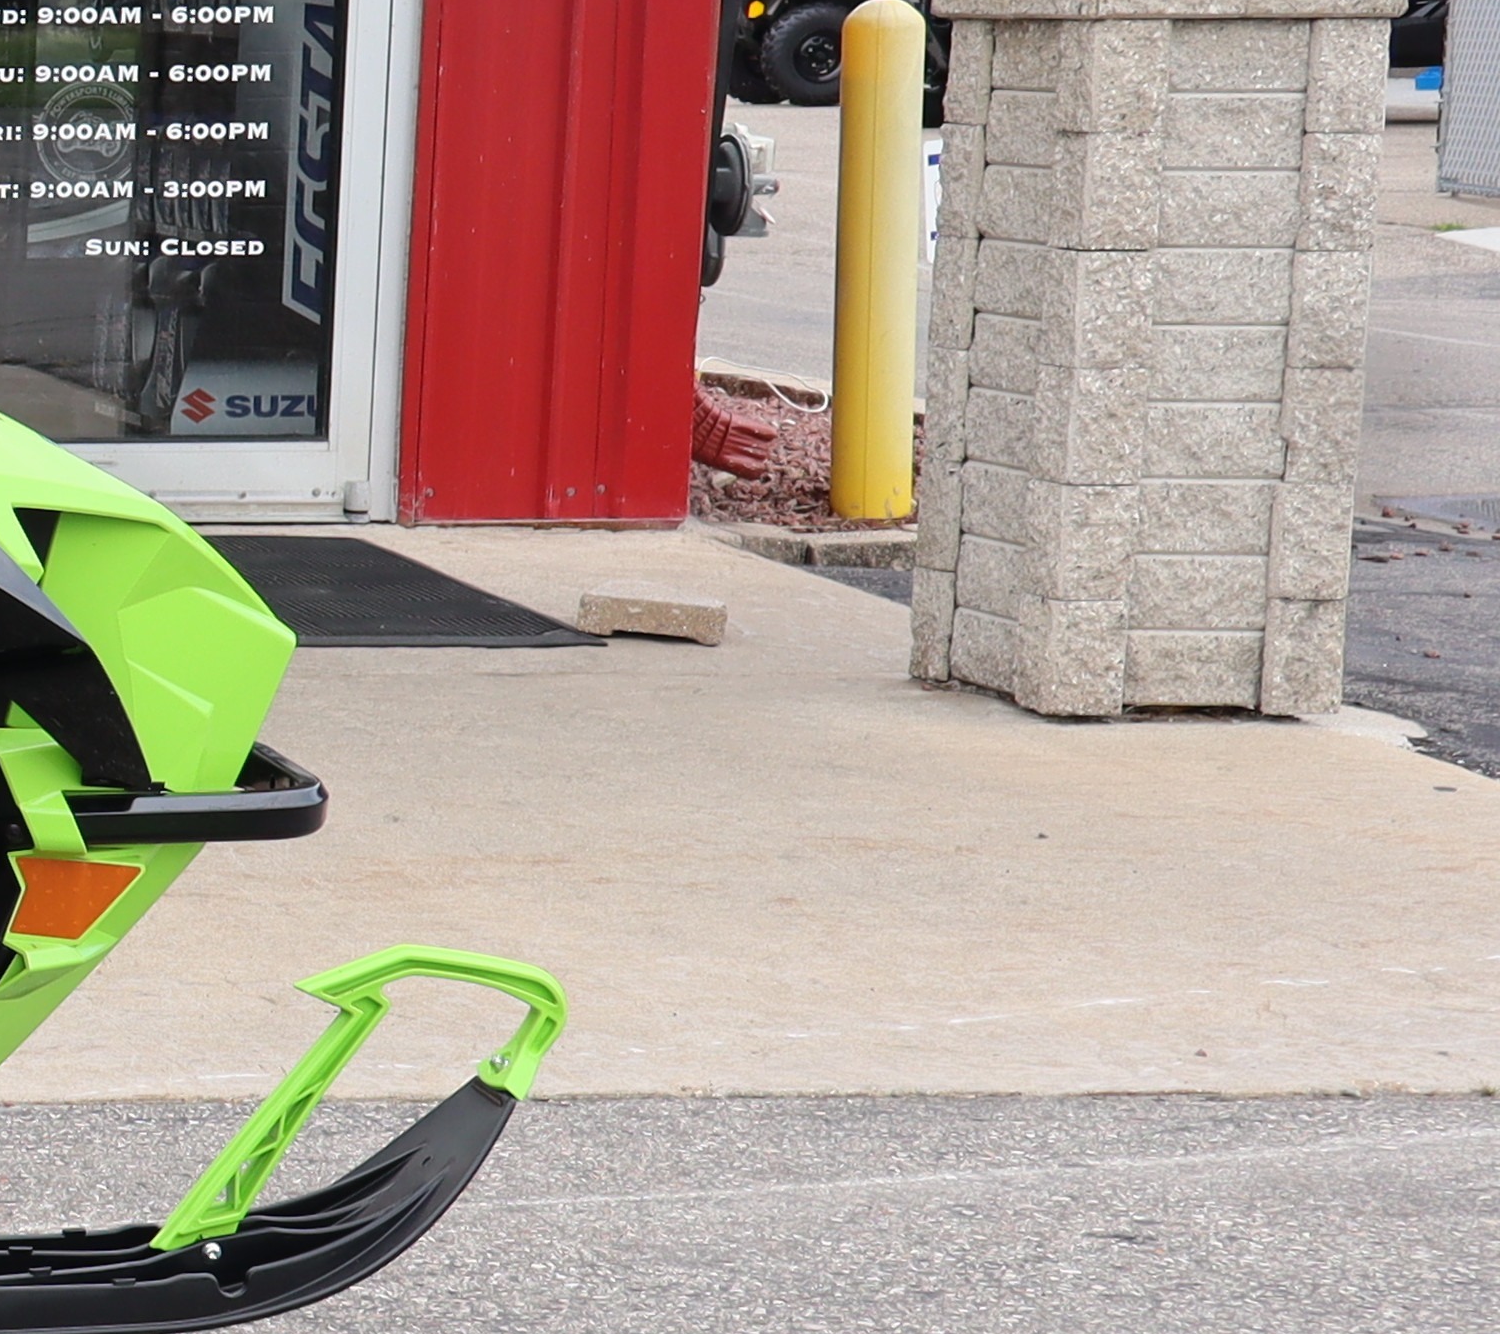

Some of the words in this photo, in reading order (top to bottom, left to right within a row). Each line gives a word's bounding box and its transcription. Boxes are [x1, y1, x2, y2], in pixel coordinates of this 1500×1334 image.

[38, 7, 142, 24] 9:00AM
[172, 6, 274, 23] 6:00PM
[35, 65, 139, 82] 9:00AM
[170, 65, 272, 82] 6:00PM
[32, 123, 136, 140] 9:00AM
[167, 123, 269, 140] 6:00PM
[30, 181, 134, 198] 9:00AM
[164, 181, 266, 198] 3:00PM
[161, 238, 264, 256] CLOSED
